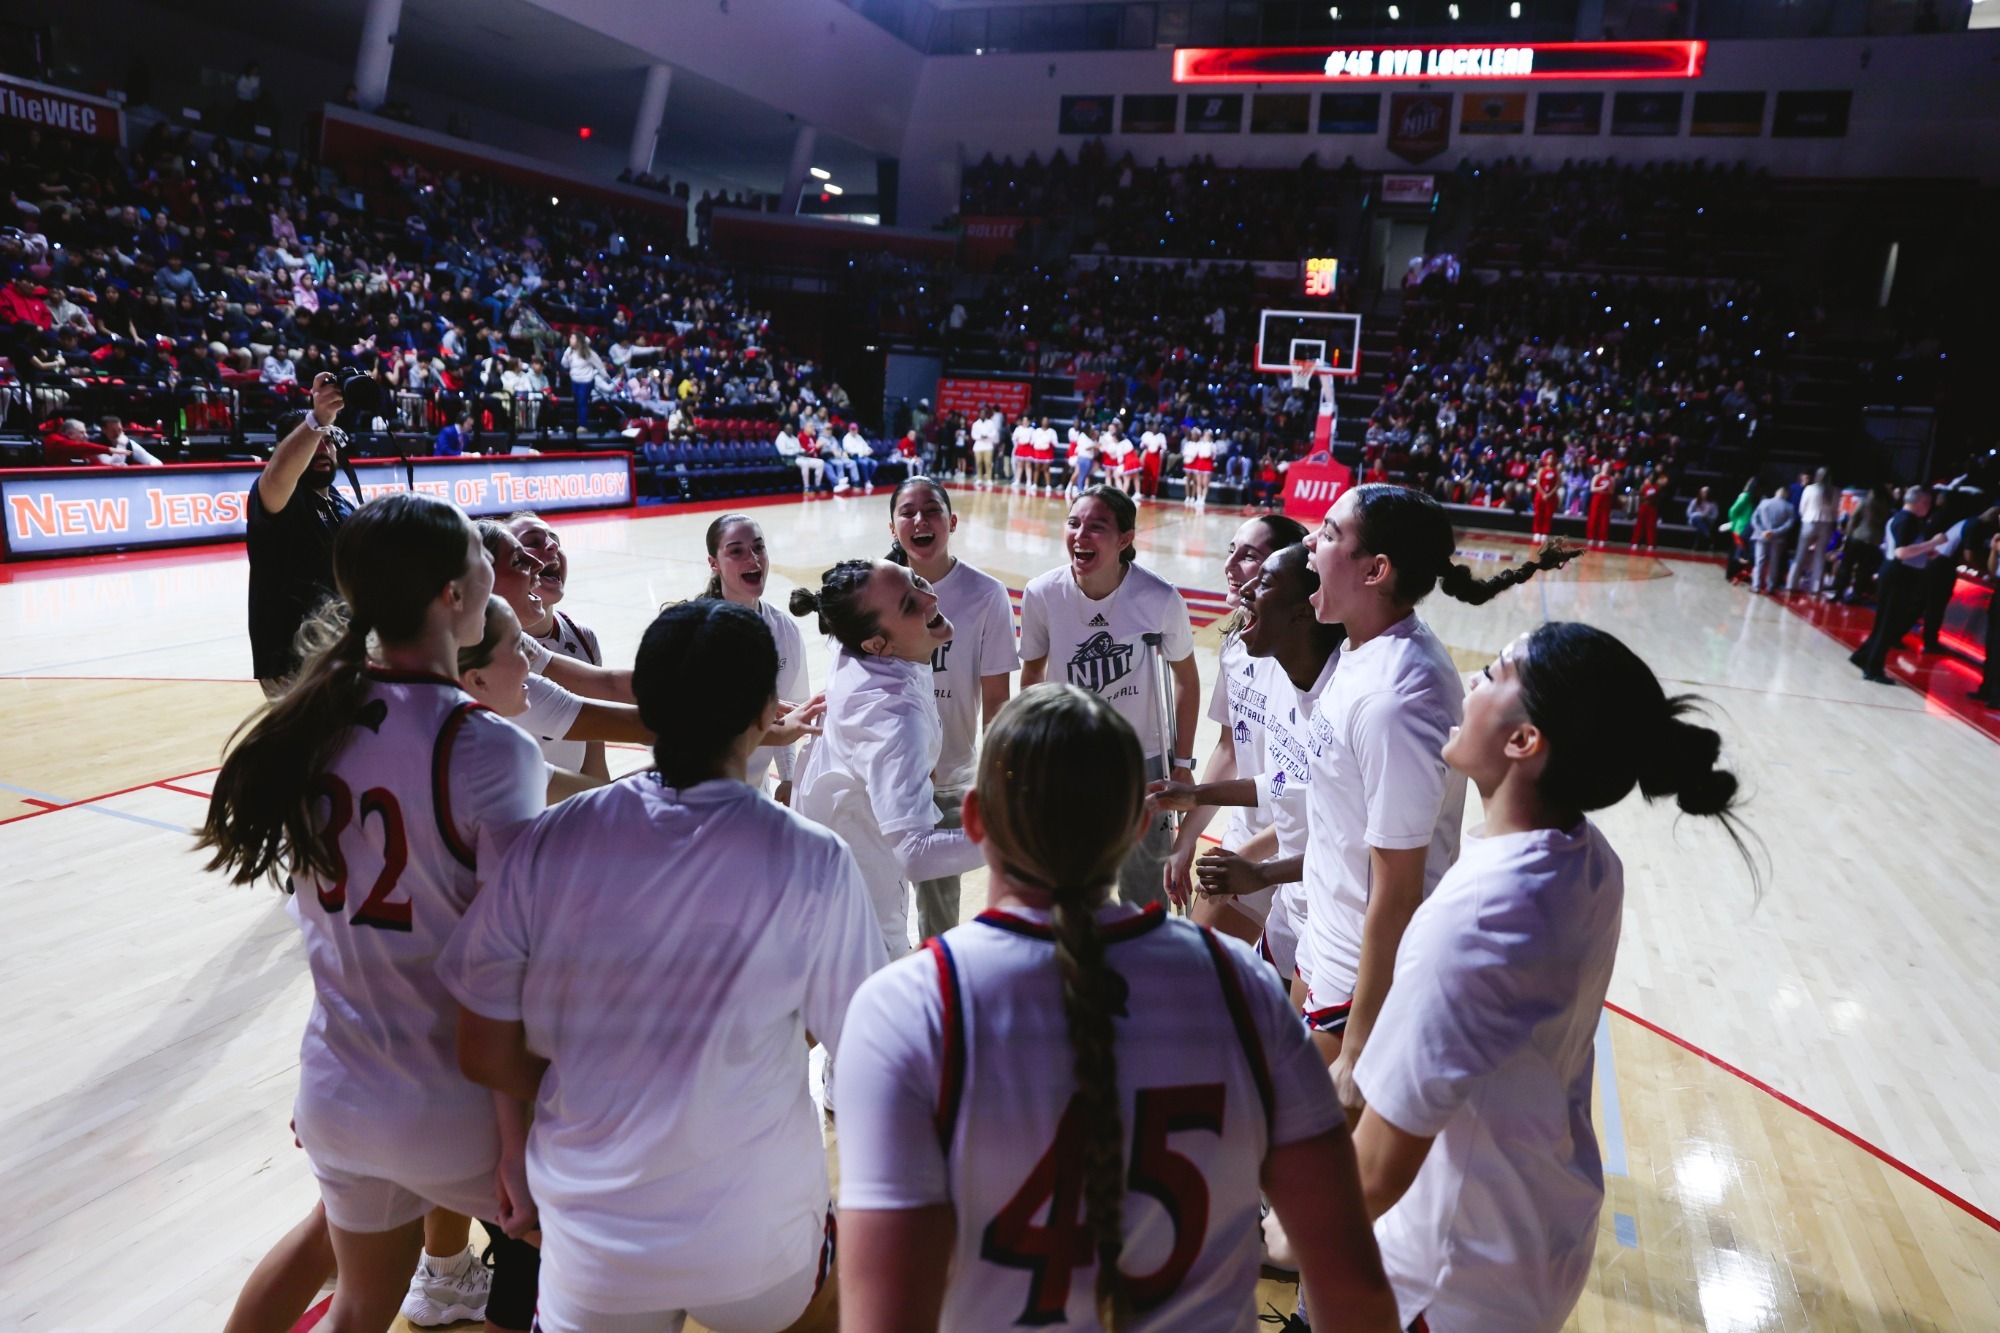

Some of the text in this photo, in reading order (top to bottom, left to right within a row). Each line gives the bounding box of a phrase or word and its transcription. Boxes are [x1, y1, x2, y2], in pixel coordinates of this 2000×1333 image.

[1324, 48, 1534, 76] #45 AVA LOCKLEAR
[1304, 271, 1332, 296] 30
[455, 479, 487, 507] OF
[491, 472, 627, 503] TECHNOLOGY
[1293, 479, 1341, 502] NJIT
[1067, 645, 1133, 695] NJIT
[981, 1083, 1226, 1328] 45
